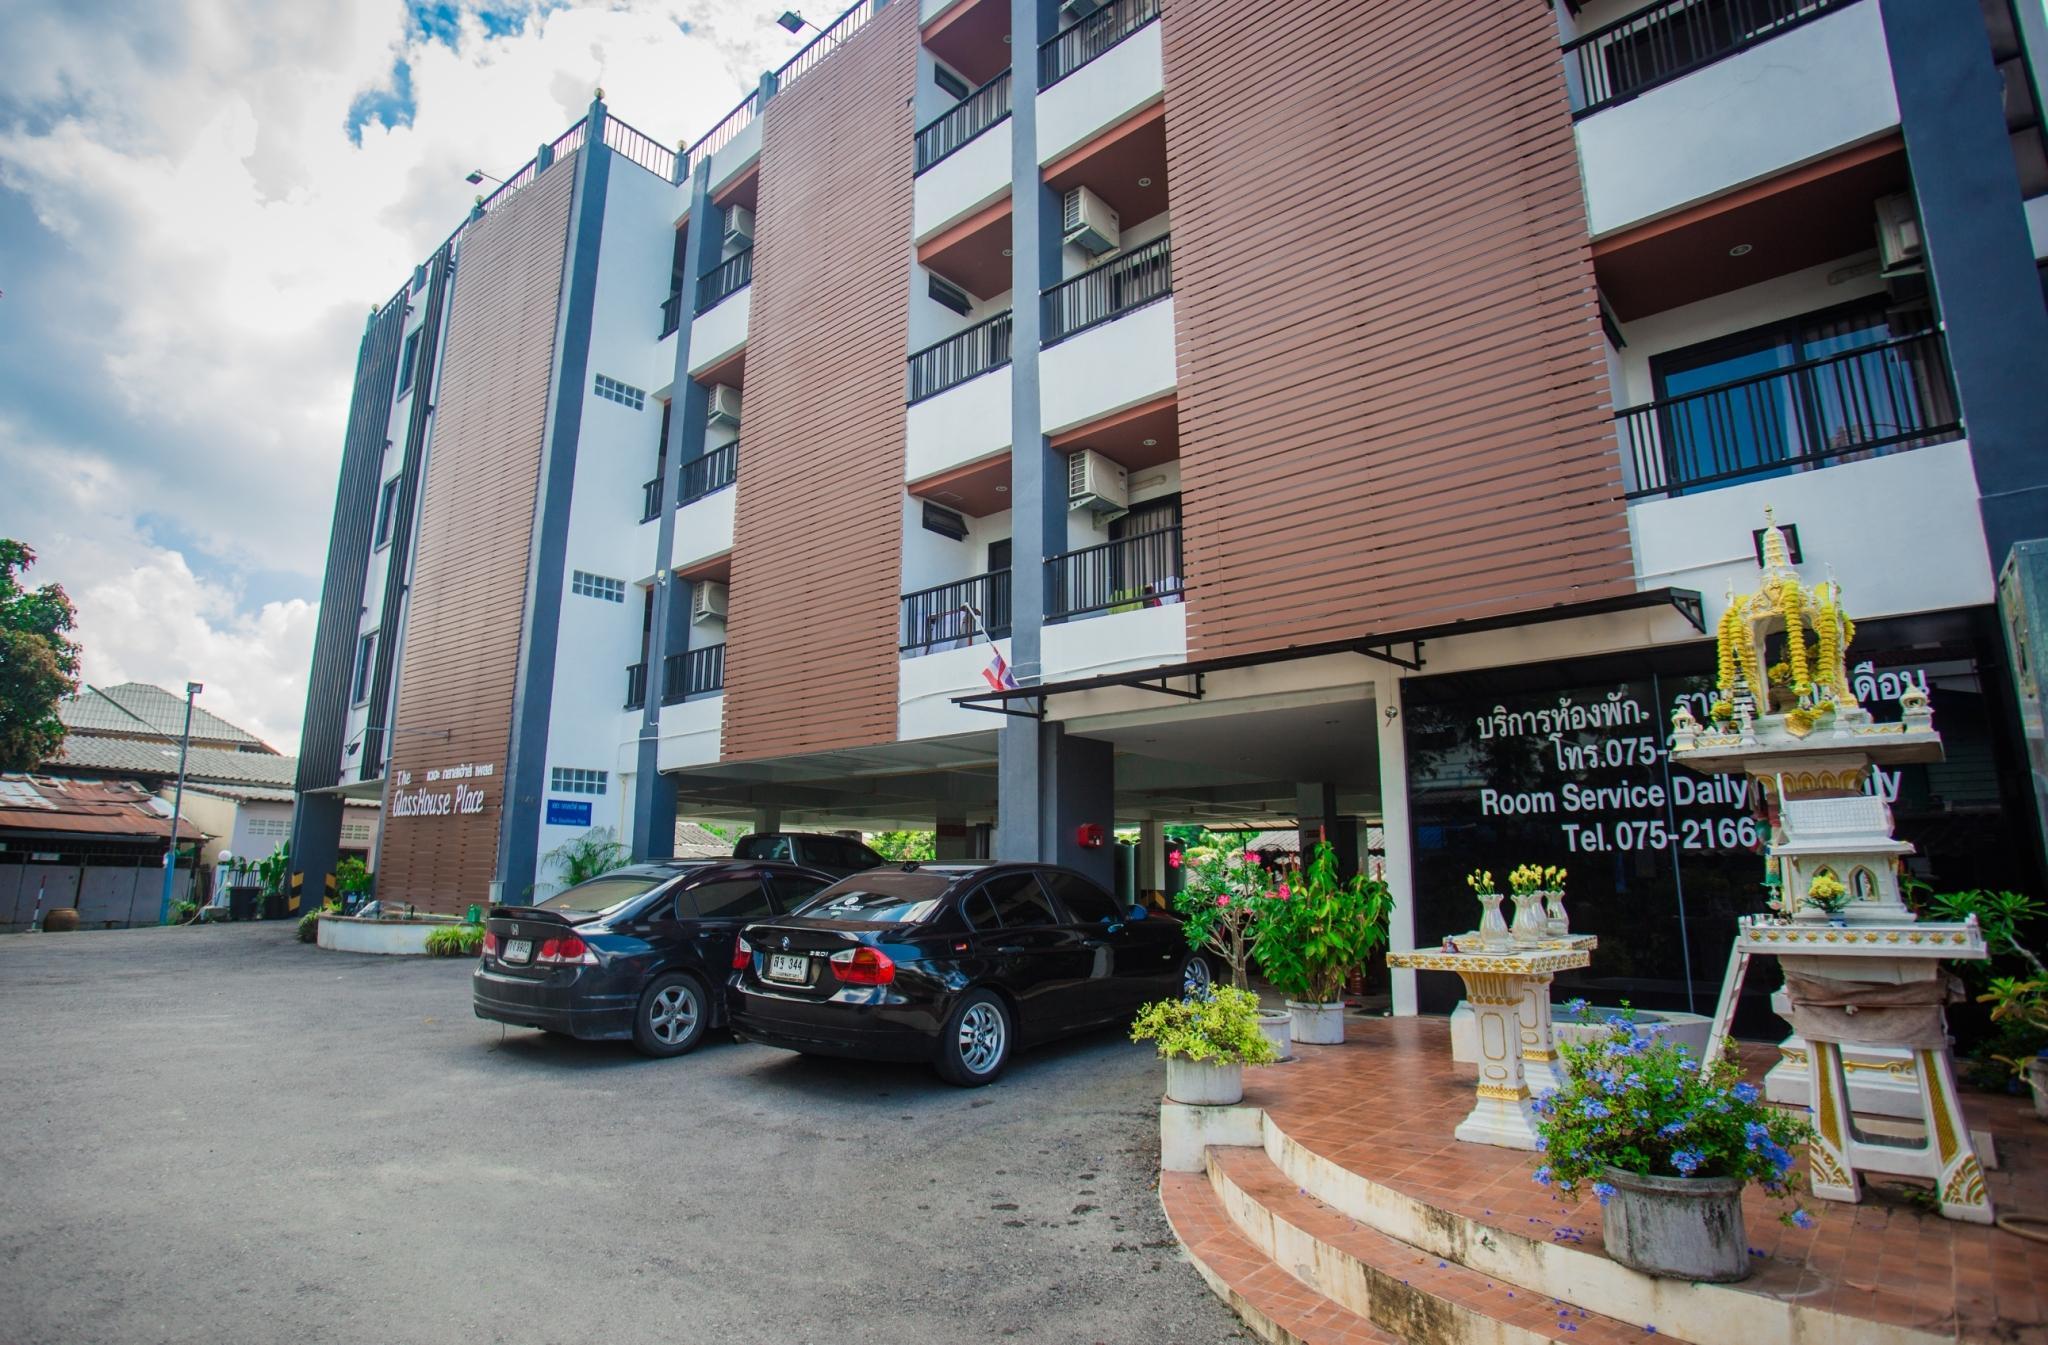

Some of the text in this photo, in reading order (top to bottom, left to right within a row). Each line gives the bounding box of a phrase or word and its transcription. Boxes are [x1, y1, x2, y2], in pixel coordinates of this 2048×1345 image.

[396, 770, 411, 786] The
[453, 784, 484, 814] Place
[1481, 785, 1556, 816] Room
[1562, 778, 1666, 812] Service
[788, 958, 802, 970] 344
